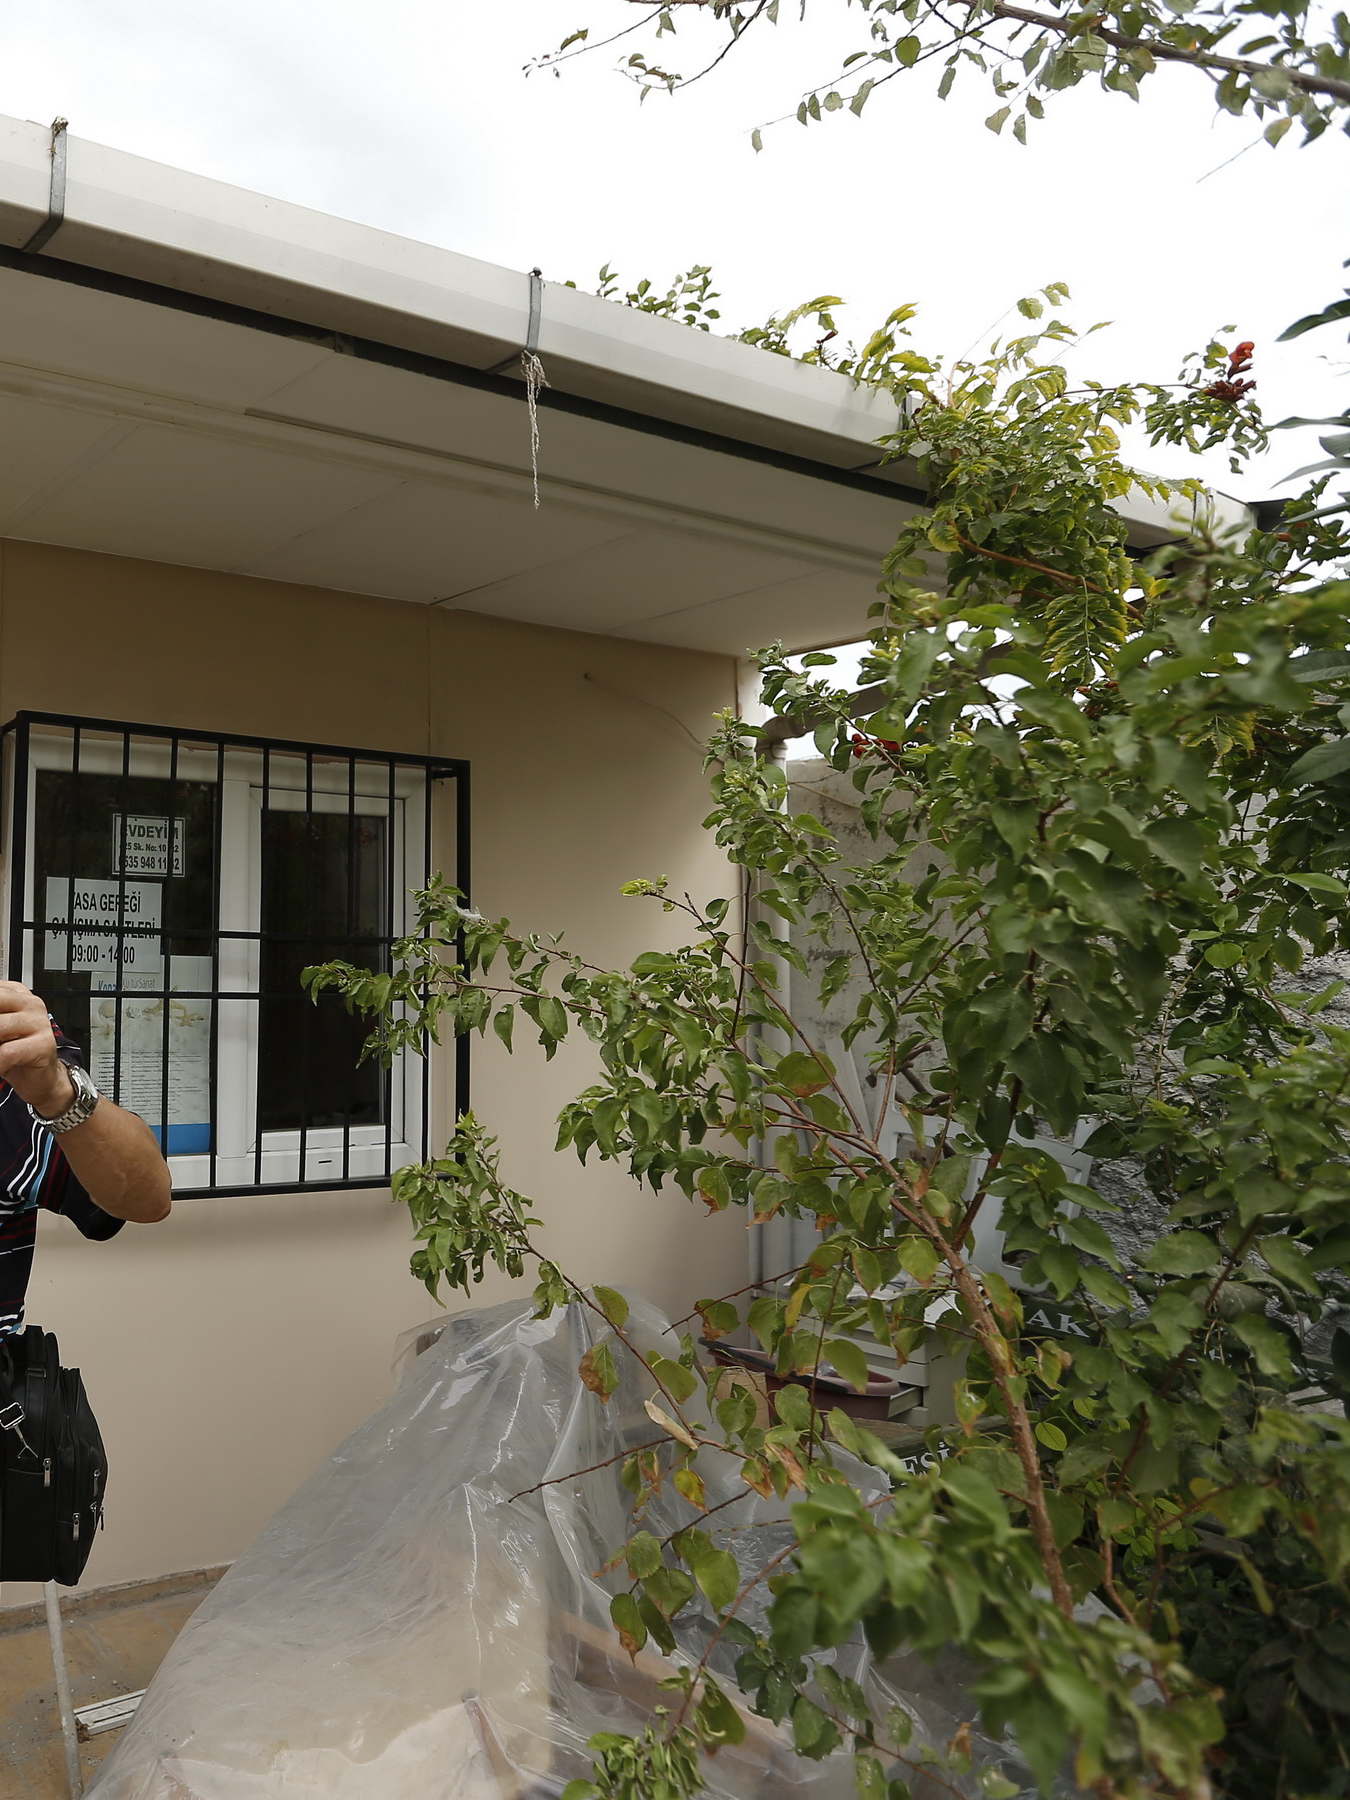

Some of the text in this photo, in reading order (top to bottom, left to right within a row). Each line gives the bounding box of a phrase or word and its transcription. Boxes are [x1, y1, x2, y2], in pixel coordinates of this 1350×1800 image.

[122, 823, 179, 839] VDEYİ
[119, 855, 138, 869] 535
[140, 856, 155, 869] 948
[71, 892, 97, 911] ASA
[52, 917, 155, 941] ÇAIŞMA SATLERİ
[72, 944, 99, 963] 09:00
[108, 946, 135, 964] 1400
[1025, 1307, 1090, 1339] AK
[890, 1441, 950, 1488] ESİ
